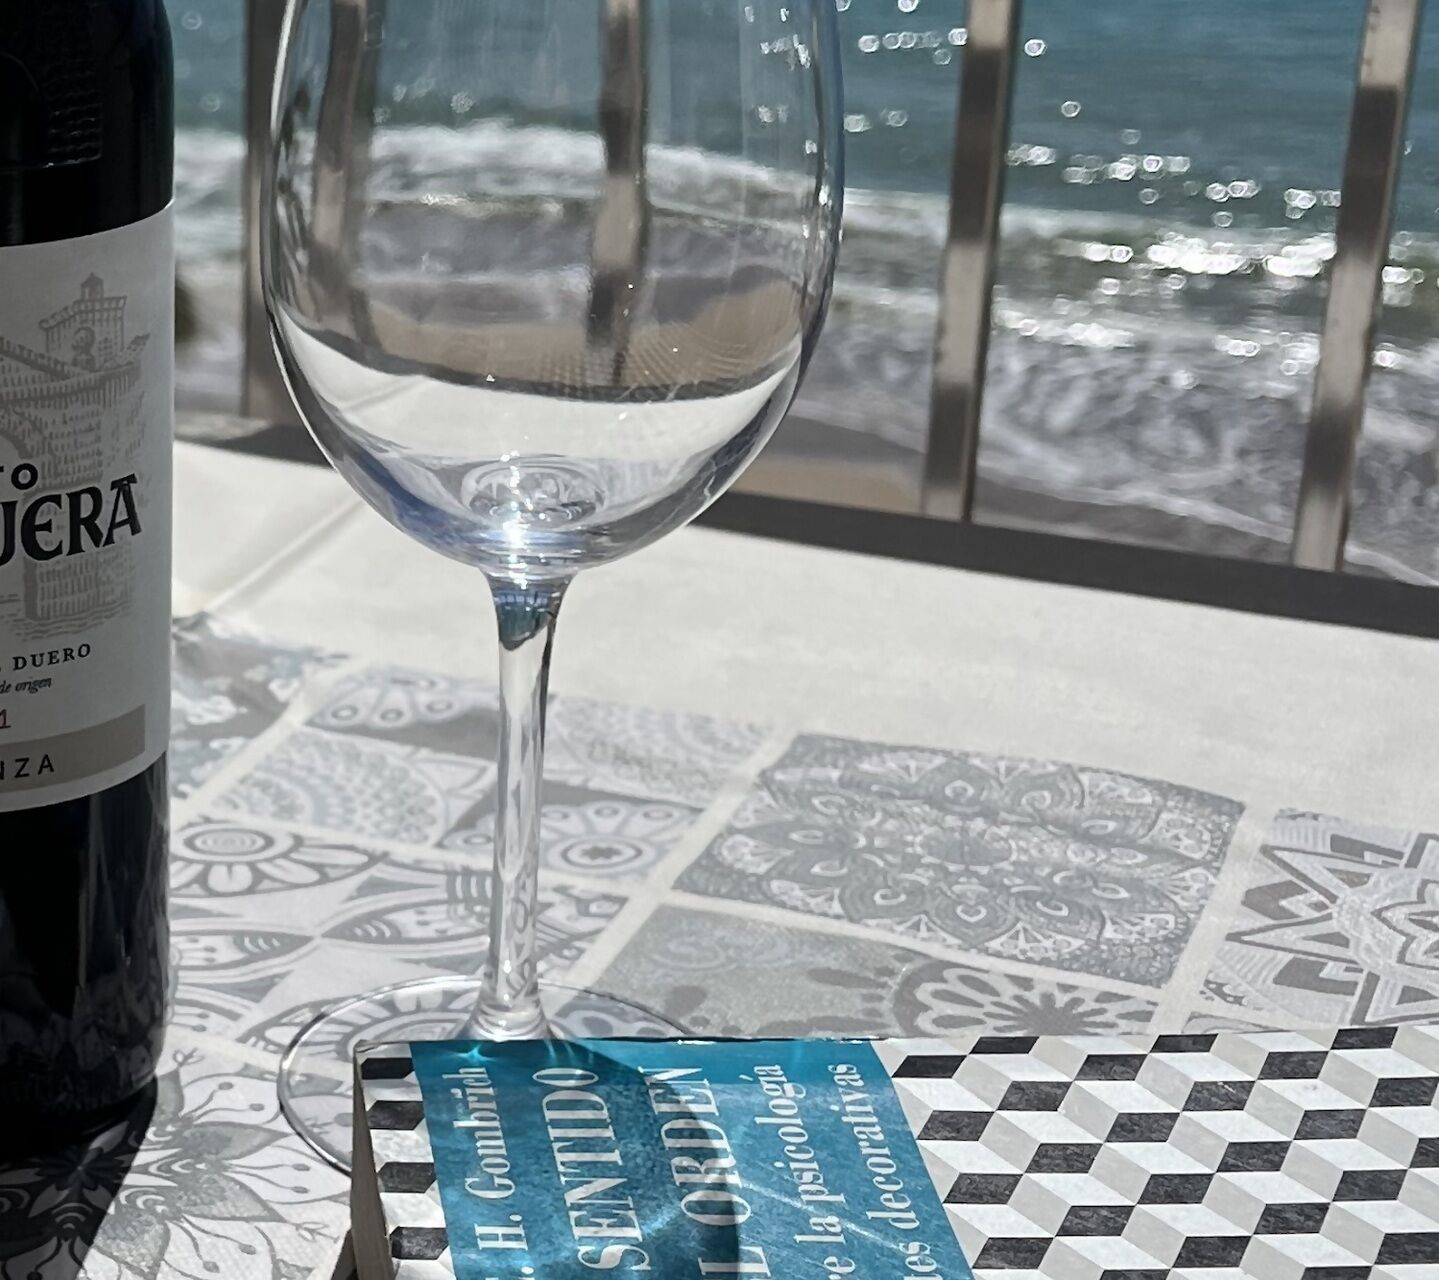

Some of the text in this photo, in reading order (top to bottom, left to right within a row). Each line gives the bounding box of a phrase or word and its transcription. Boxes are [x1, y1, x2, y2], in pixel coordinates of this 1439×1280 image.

[12, 643, 91, 671] DUERO
[15, 676, 52, 694] origen
[442, 1067, 516, 1199] Gombrich
[532, 1067, 652, 1271] SENTIDO
[638, 1066, 752, 1226] ORDEN
[739, 1064, 847, 1205] psicología
[827, 1063, 920, 1230] decorativas
[474, 1214, 529, 1251] H.
[793, 1215, 846, 1245] la
